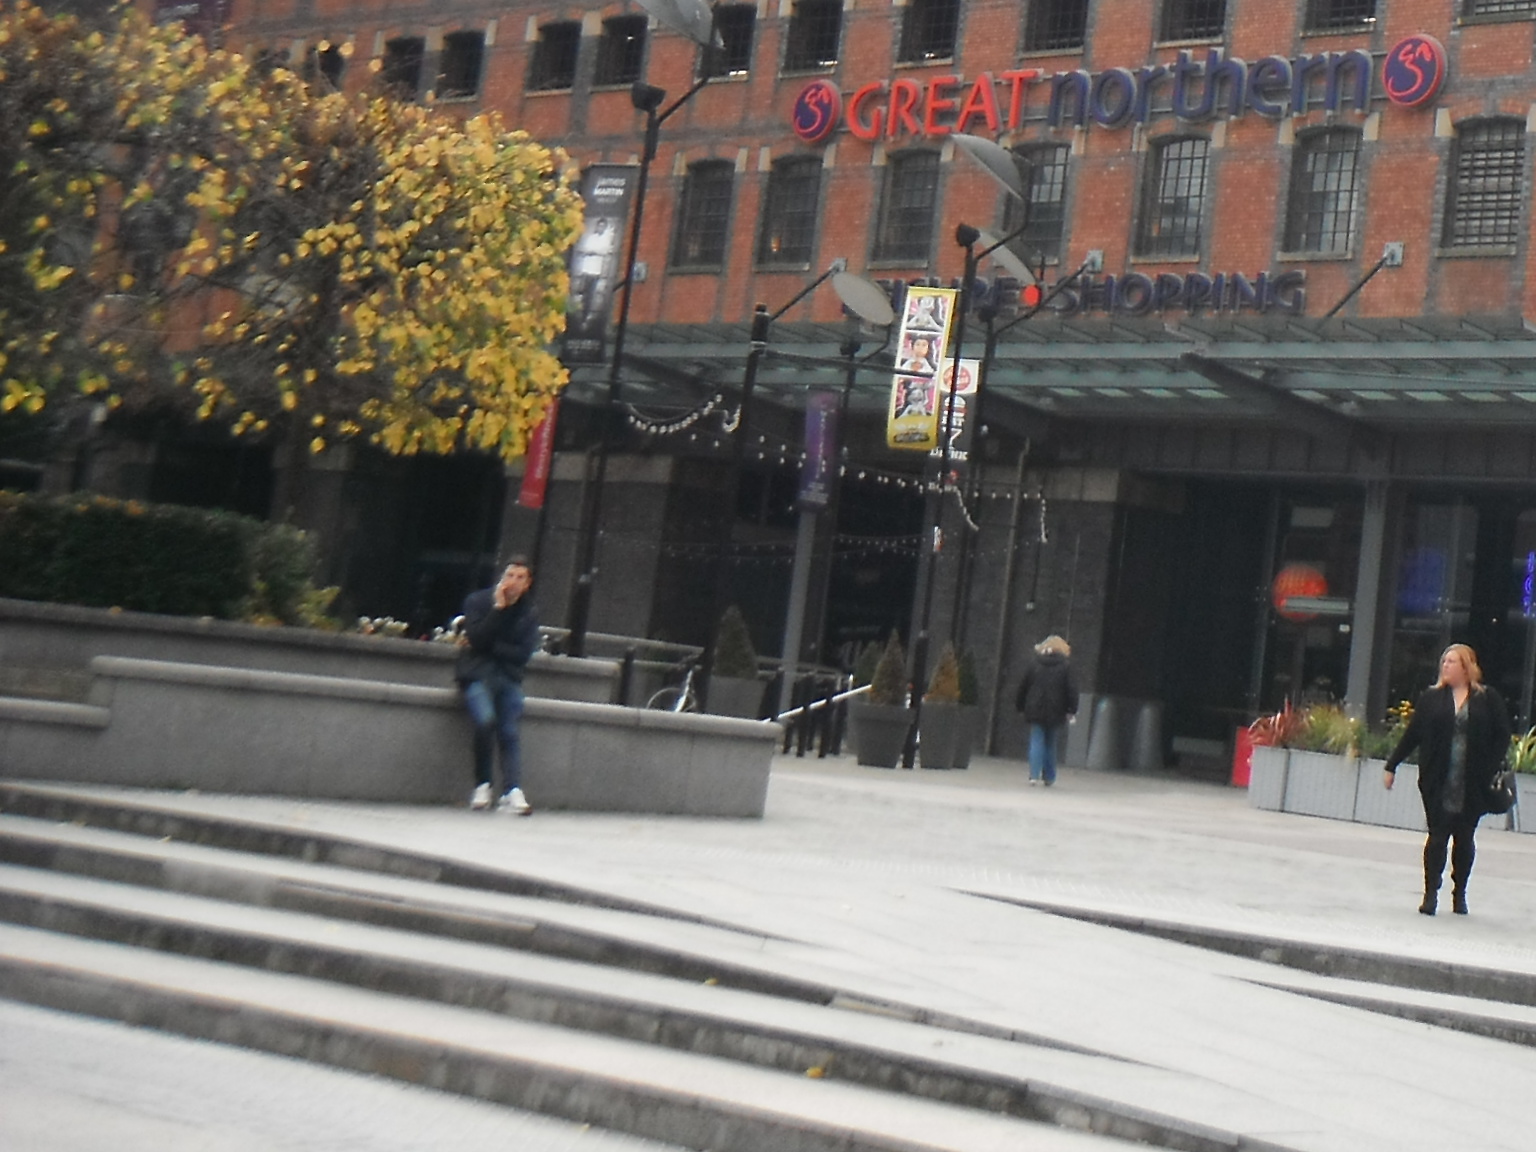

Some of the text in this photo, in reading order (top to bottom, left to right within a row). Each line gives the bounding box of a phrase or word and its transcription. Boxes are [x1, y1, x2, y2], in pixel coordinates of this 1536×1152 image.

[846, 48, 1374, 138] GREAT northern
[1052, 271, 1306, 316] SHOPPING
